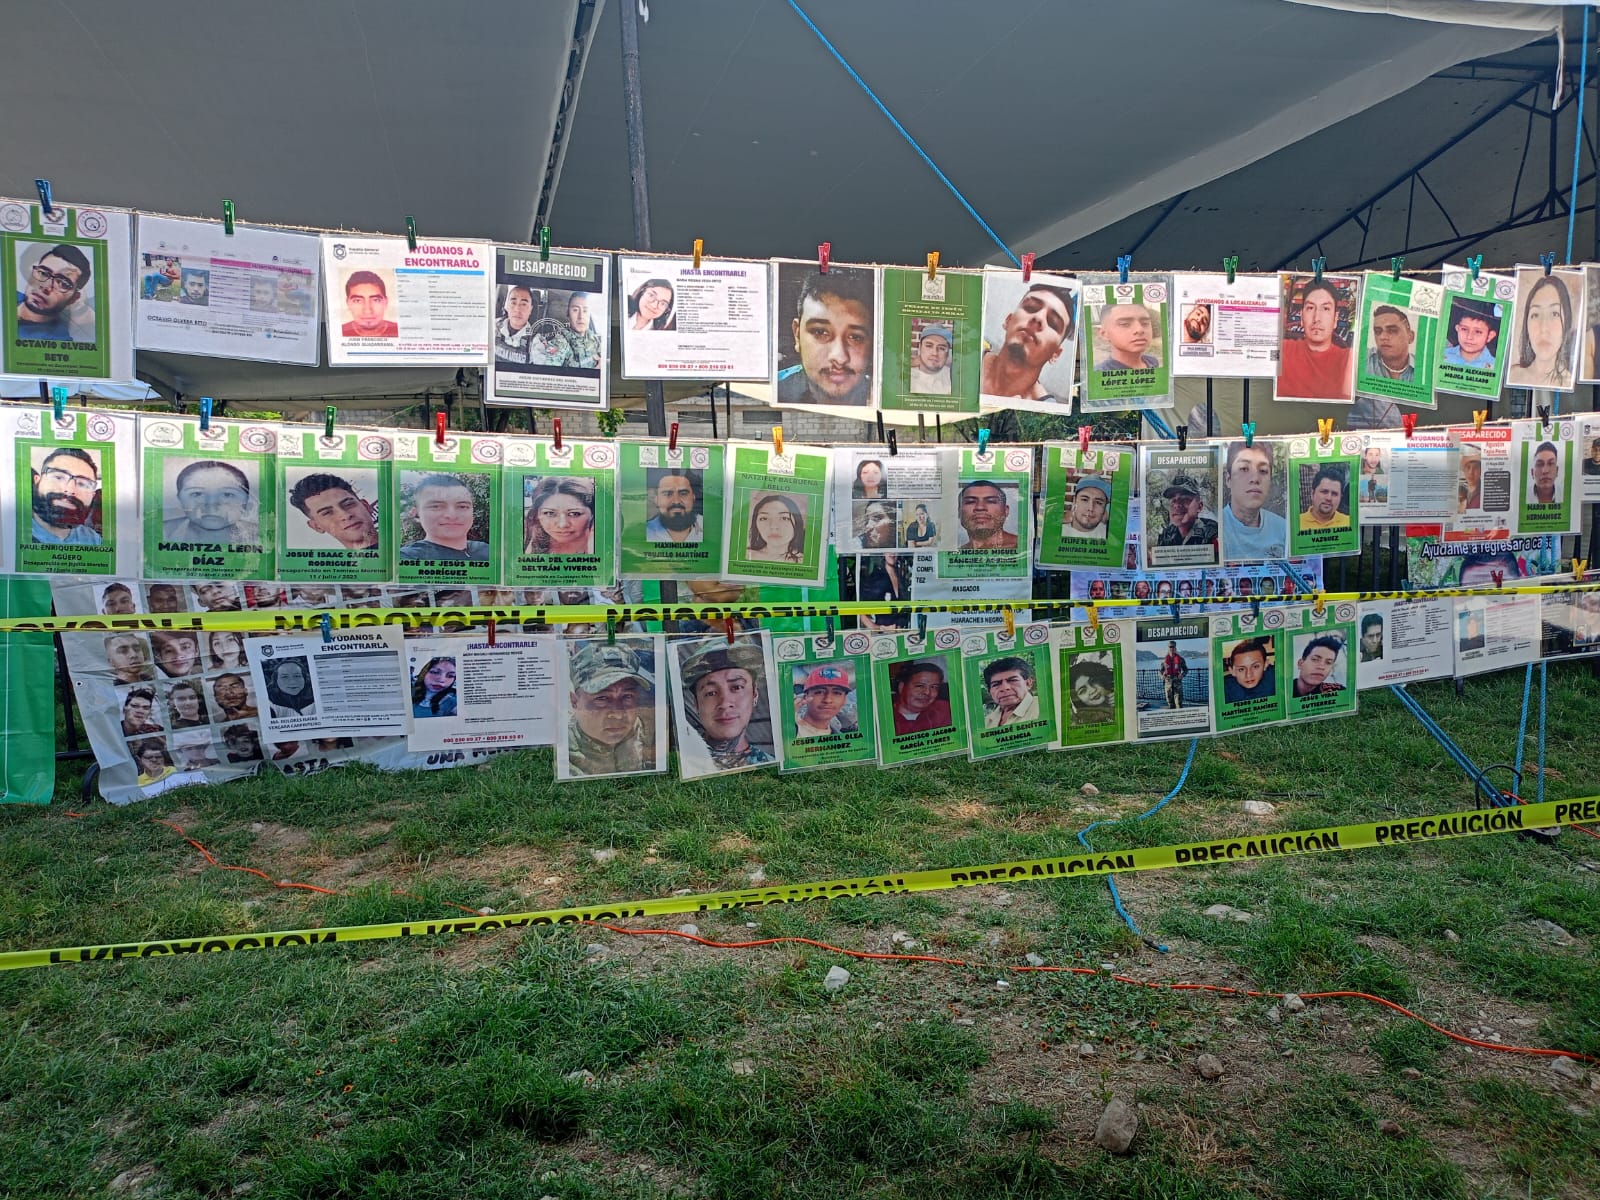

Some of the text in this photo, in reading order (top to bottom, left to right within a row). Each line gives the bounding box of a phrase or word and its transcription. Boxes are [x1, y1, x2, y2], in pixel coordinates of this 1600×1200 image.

[409, 243, 474, 256] AYÚDANOS A
[404, 258, 480, 269] ENCONTRARLO
[513, 259, 587, 278] DESAPARECIDO
[680, 268, 747, 278] ¡HASTA ENCONTRARLE!
[16, 339, 98, 352] OCTAVIO OLVERA
[44, 353, 69, 362] BETO
[1130, 367, 1155, 376] JOSUÉ
[1439, 364, 1464, 373] ANTONIO
[1102, 377, 1156, 386] LÓPEZ LÓPEZ
[1157, 456, 1208, 465] DESAPARECIDO
[742, 473, 777, 482] NATZIELY
[768, 484, 791, 492] BELLO
[1297, 527, 1312, 536] JOSÉ
[1313, 527, 1332, 535] DAVID
[158, 543, 222, 553] MARITZA
[1471, 545, 1478, 554] a
[1480, 538, 1524, 558] regresar
[1525, 540, 1531, 550] a
[286, 550, 314, 558] JOSUÉ
[347, 550, 379, 559] GARCÍA
[676, 550, 709, 558] MARTÍNEZ
[192, 554, 225, 566] DÍAZ
[399, 559, 420, 567] JOSÉ
[419, 568, 468, 576] RODRÍGUEZ
[522, 564, 560, 572] BELTRÁN
[952, 585, 980, 593] RASGADOS
[1148, 625, 1198, 638] DESAPARECIDO
[330, 634, 374, 643] YÚDANOS
[321, 642, 389, 652] ENCONTRARLA
[1302, 700, 1337, 709] GUTIERREZ
[1222, 703, 1278, 717] MARTÍNEZ RAMÍREZ
[981, 720, 1048, 739] BERNABÉ BENÍTEZ
[792, 737, 815, 746] JESÚS
[893, 732, 930, 744] FRANCISCO
[996, 732, 1032, 743] VALENCIA
[805, 743, 851, 753] HERNANDEZ
[900, 740, 925, 750] GARCÍA
[927, 736, 951, 745] FLORES
[1376, 810, 1523, 844] PRECAUCIÓN
[1176, 832, 1338, 863] PRECAUCIÓN
